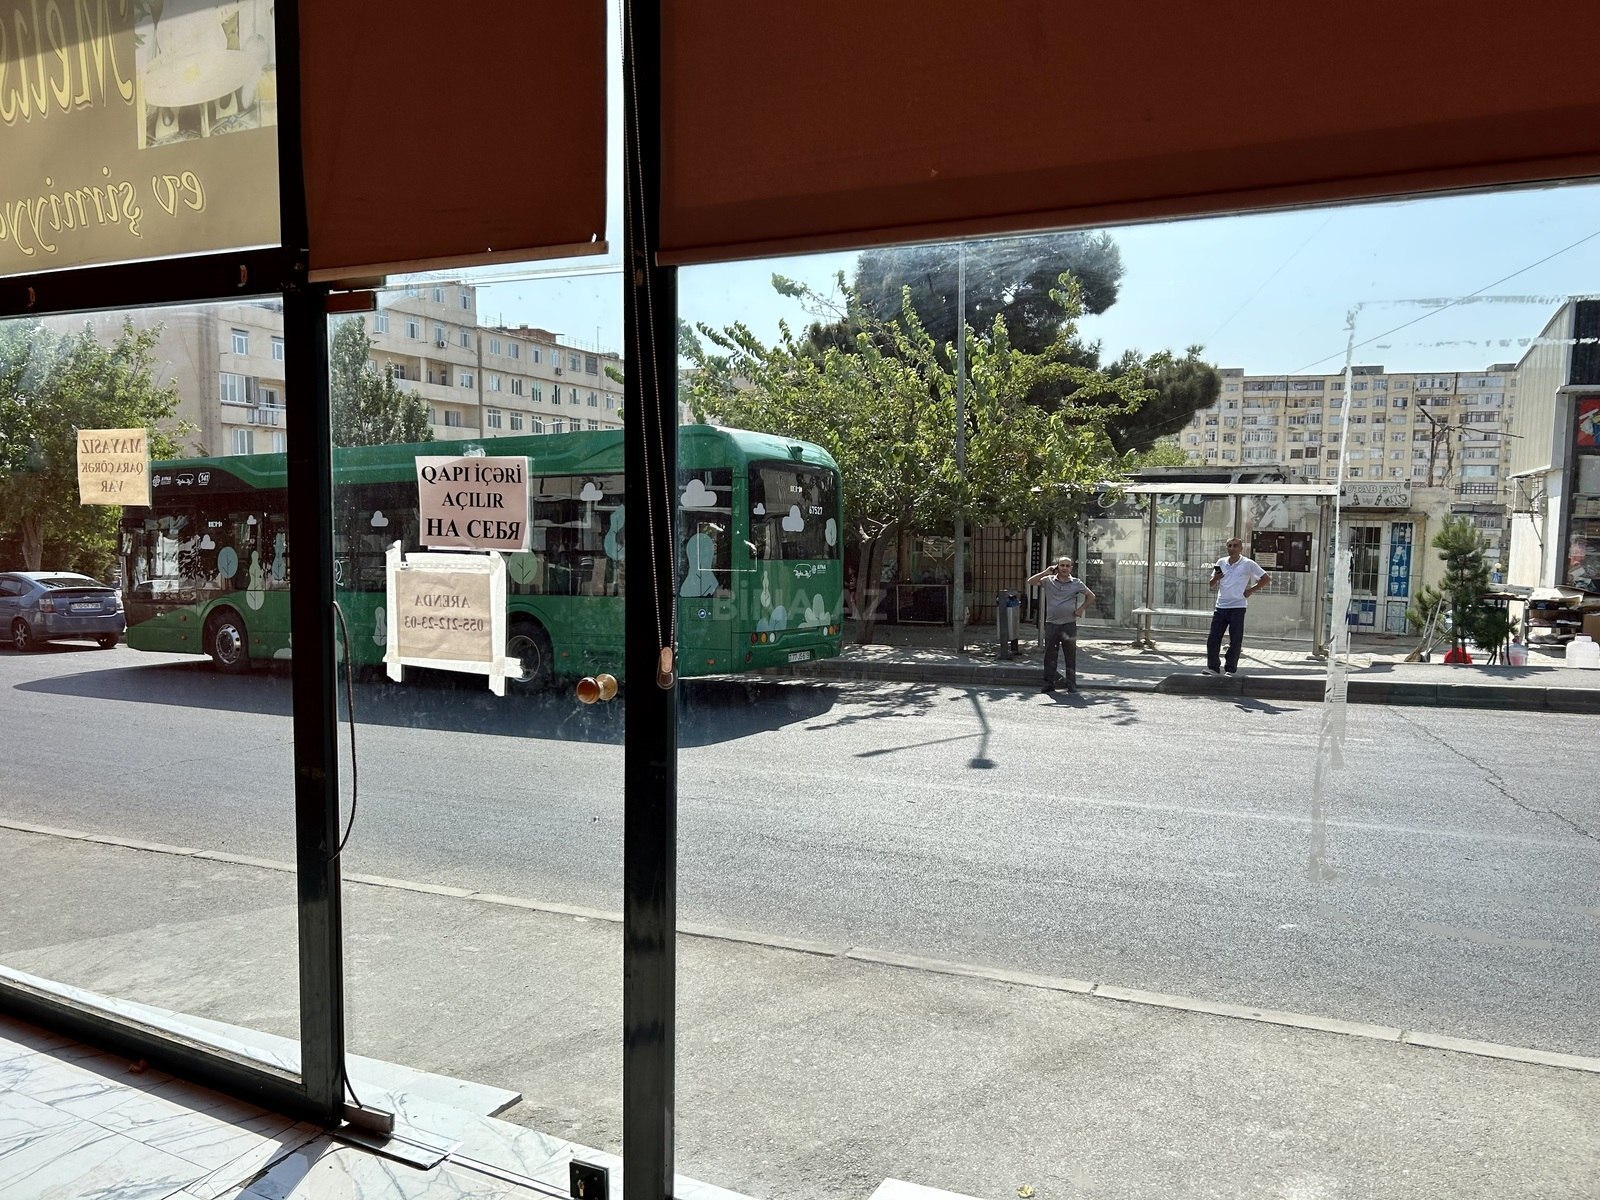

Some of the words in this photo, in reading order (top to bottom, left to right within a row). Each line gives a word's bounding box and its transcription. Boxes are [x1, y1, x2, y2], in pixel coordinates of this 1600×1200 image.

[421, 465, 470, 485] QAPI
[475, 463, 523, 487] İÇƏRİ
[1340, 484, 1378, 495] UTAB
[441, 491, 505, 510] AÇILIR
[808, 505, 824, 516] 67527
[1155, 512, 1203, 525] Salonu
[425, 518, 460, 537] НА
[466, 519, 522, 541] СЕБЯ
